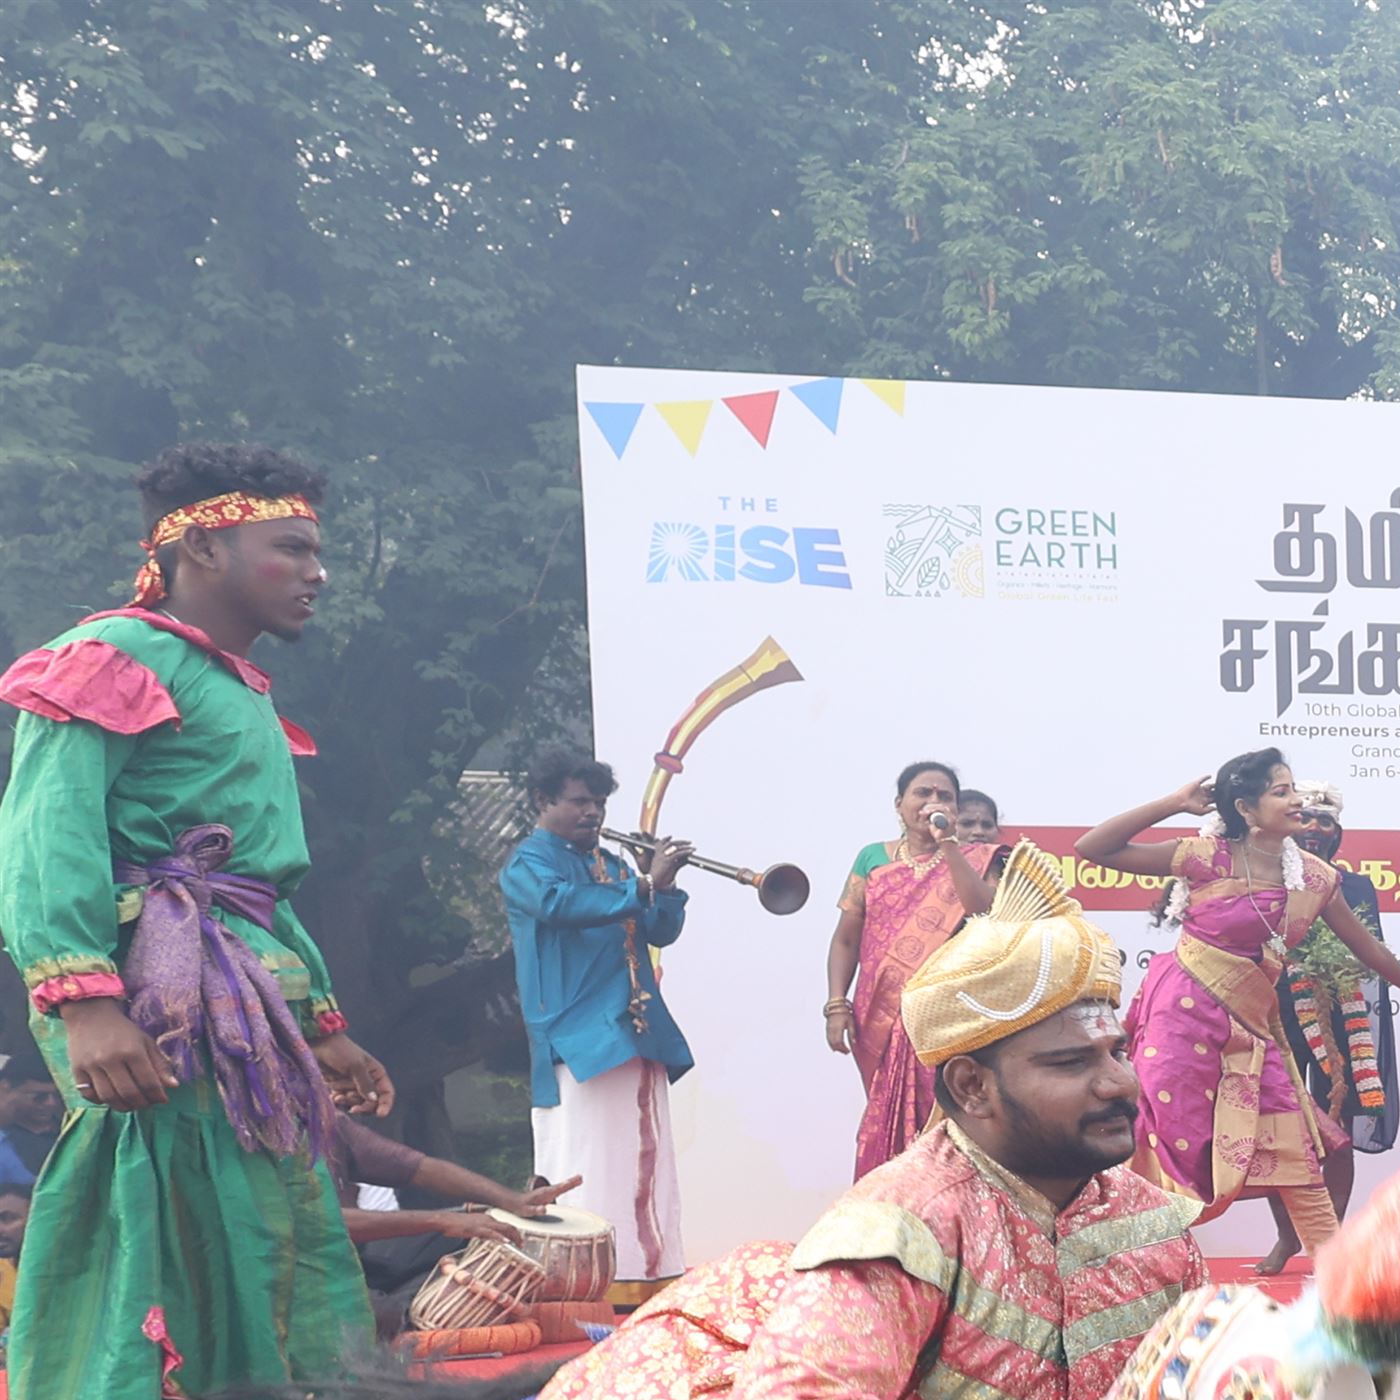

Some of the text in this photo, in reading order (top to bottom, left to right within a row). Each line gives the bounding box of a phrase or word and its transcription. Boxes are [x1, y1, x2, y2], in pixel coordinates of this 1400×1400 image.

[717, 496, 778, 512] THE
[995, 507, 1117, 537] GREEN
[645, 521, 853, 590] RISE
[995, 540, 1118, 570] EARTH
[1305, 702, 1342, 718] 10th
[1259, 722, 1390, 741] Entrepreneurs
[1350, 764, 1380, 779] Jan
